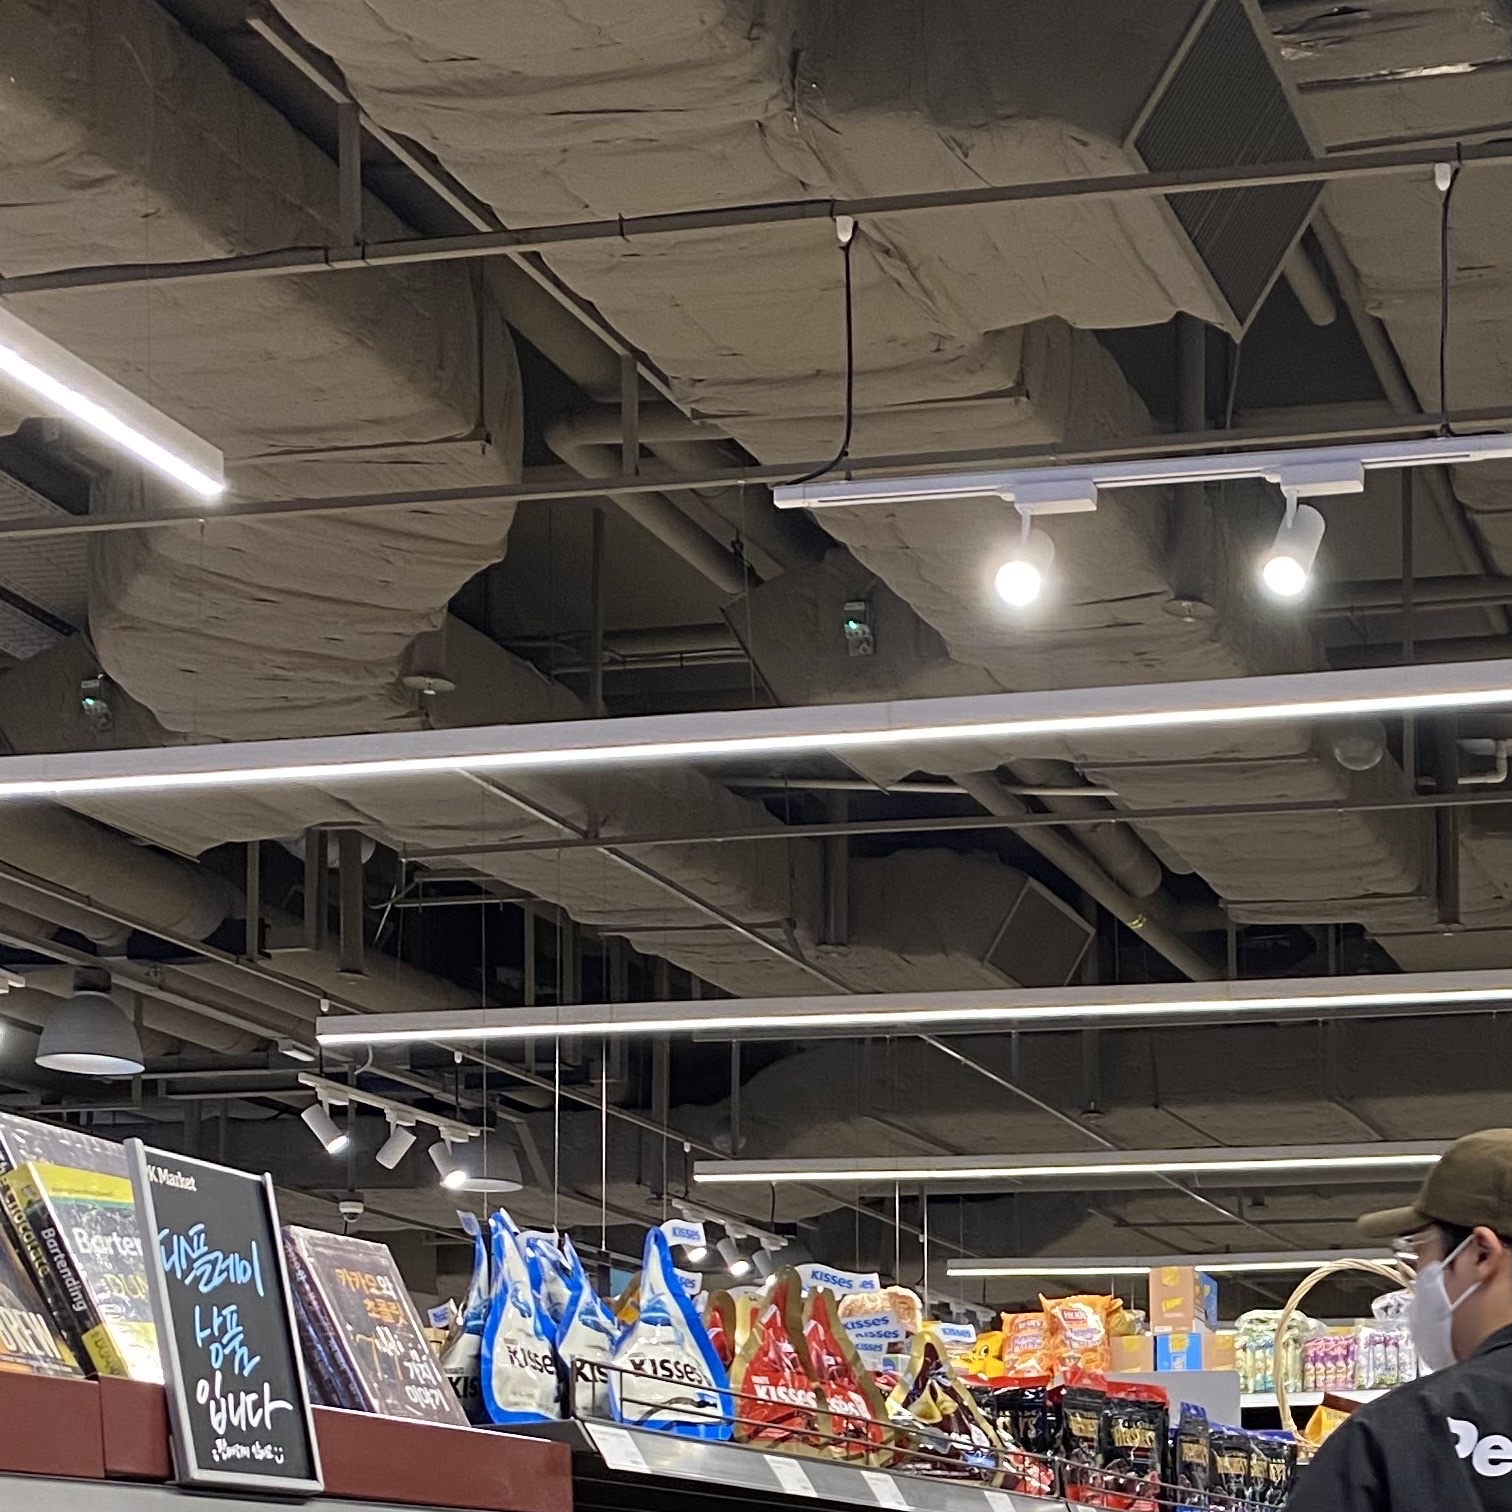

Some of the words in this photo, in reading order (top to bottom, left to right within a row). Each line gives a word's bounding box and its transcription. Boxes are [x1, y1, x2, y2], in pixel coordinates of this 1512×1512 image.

[158, 1167, 197, 1192] Market
[41, 1227, 88, 1312] Bartending
[335, 1268, 396, 1300] 카카오와
[810, 1269, 854, 1289] KISSES
[194, 1304, 261, 1377] 상품
[941, 1327, 972, 1338] KISSES
[196, 1370, 293, 1436] 입니다
[404, 1384, 450, 1412] 이야기
